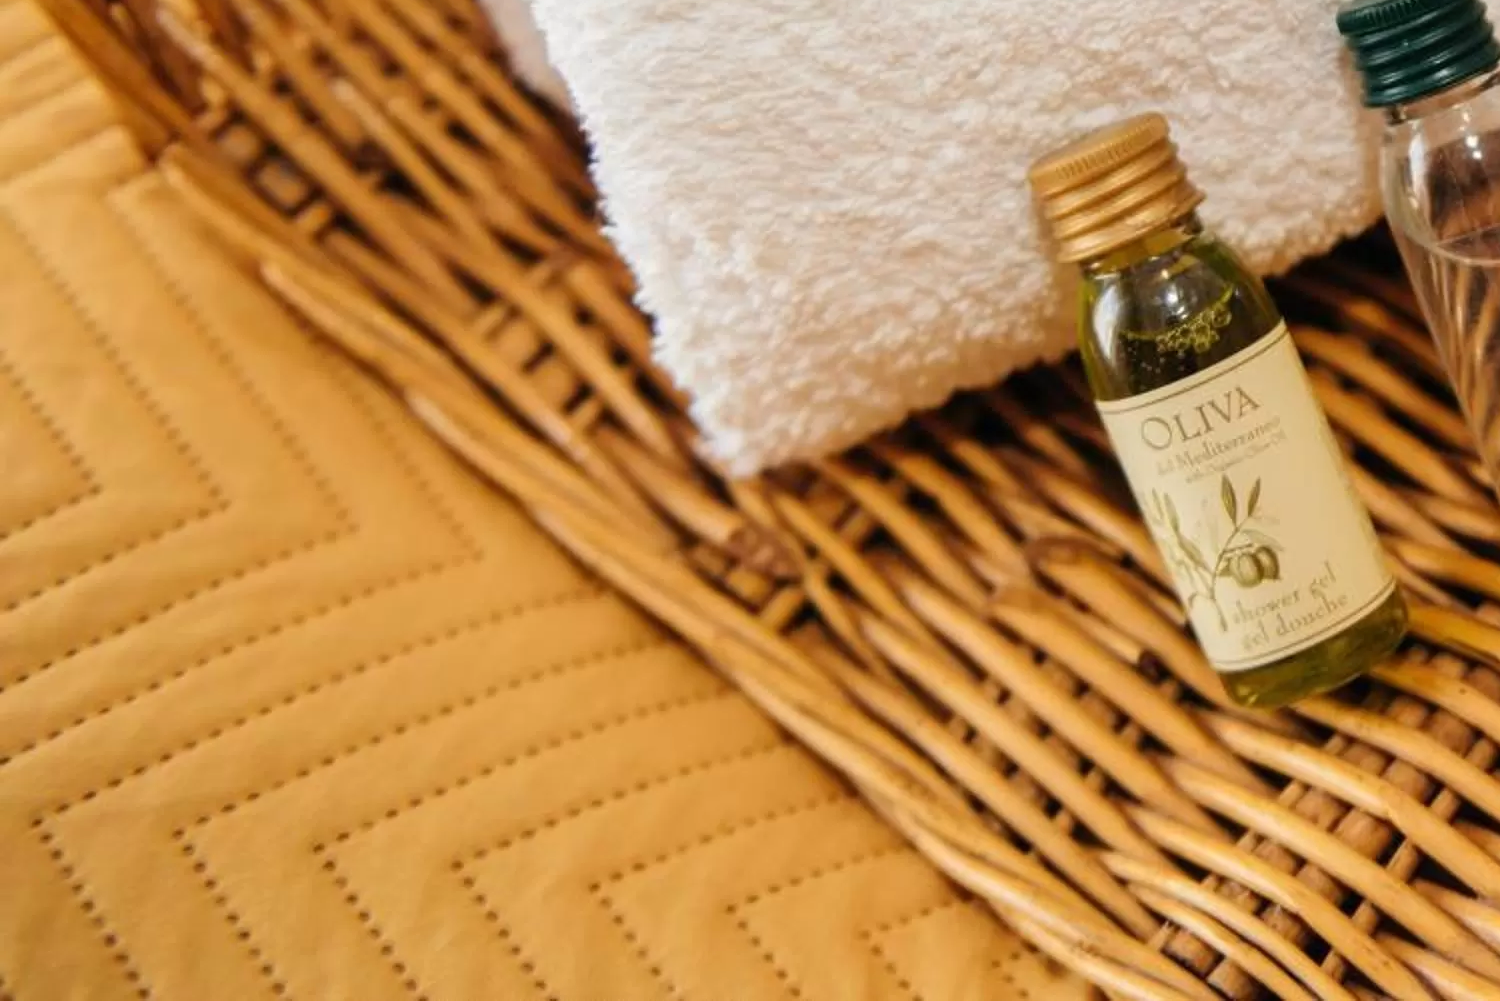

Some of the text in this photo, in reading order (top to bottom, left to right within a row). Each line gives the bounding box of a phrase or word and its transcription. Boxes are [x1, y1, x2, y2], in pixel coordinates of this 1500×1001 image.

[1141, 385, 1262, 450] OLIVA
[1232, 561, 1338, 626] shower gel
[1275, 594, 1350, 634] douche
